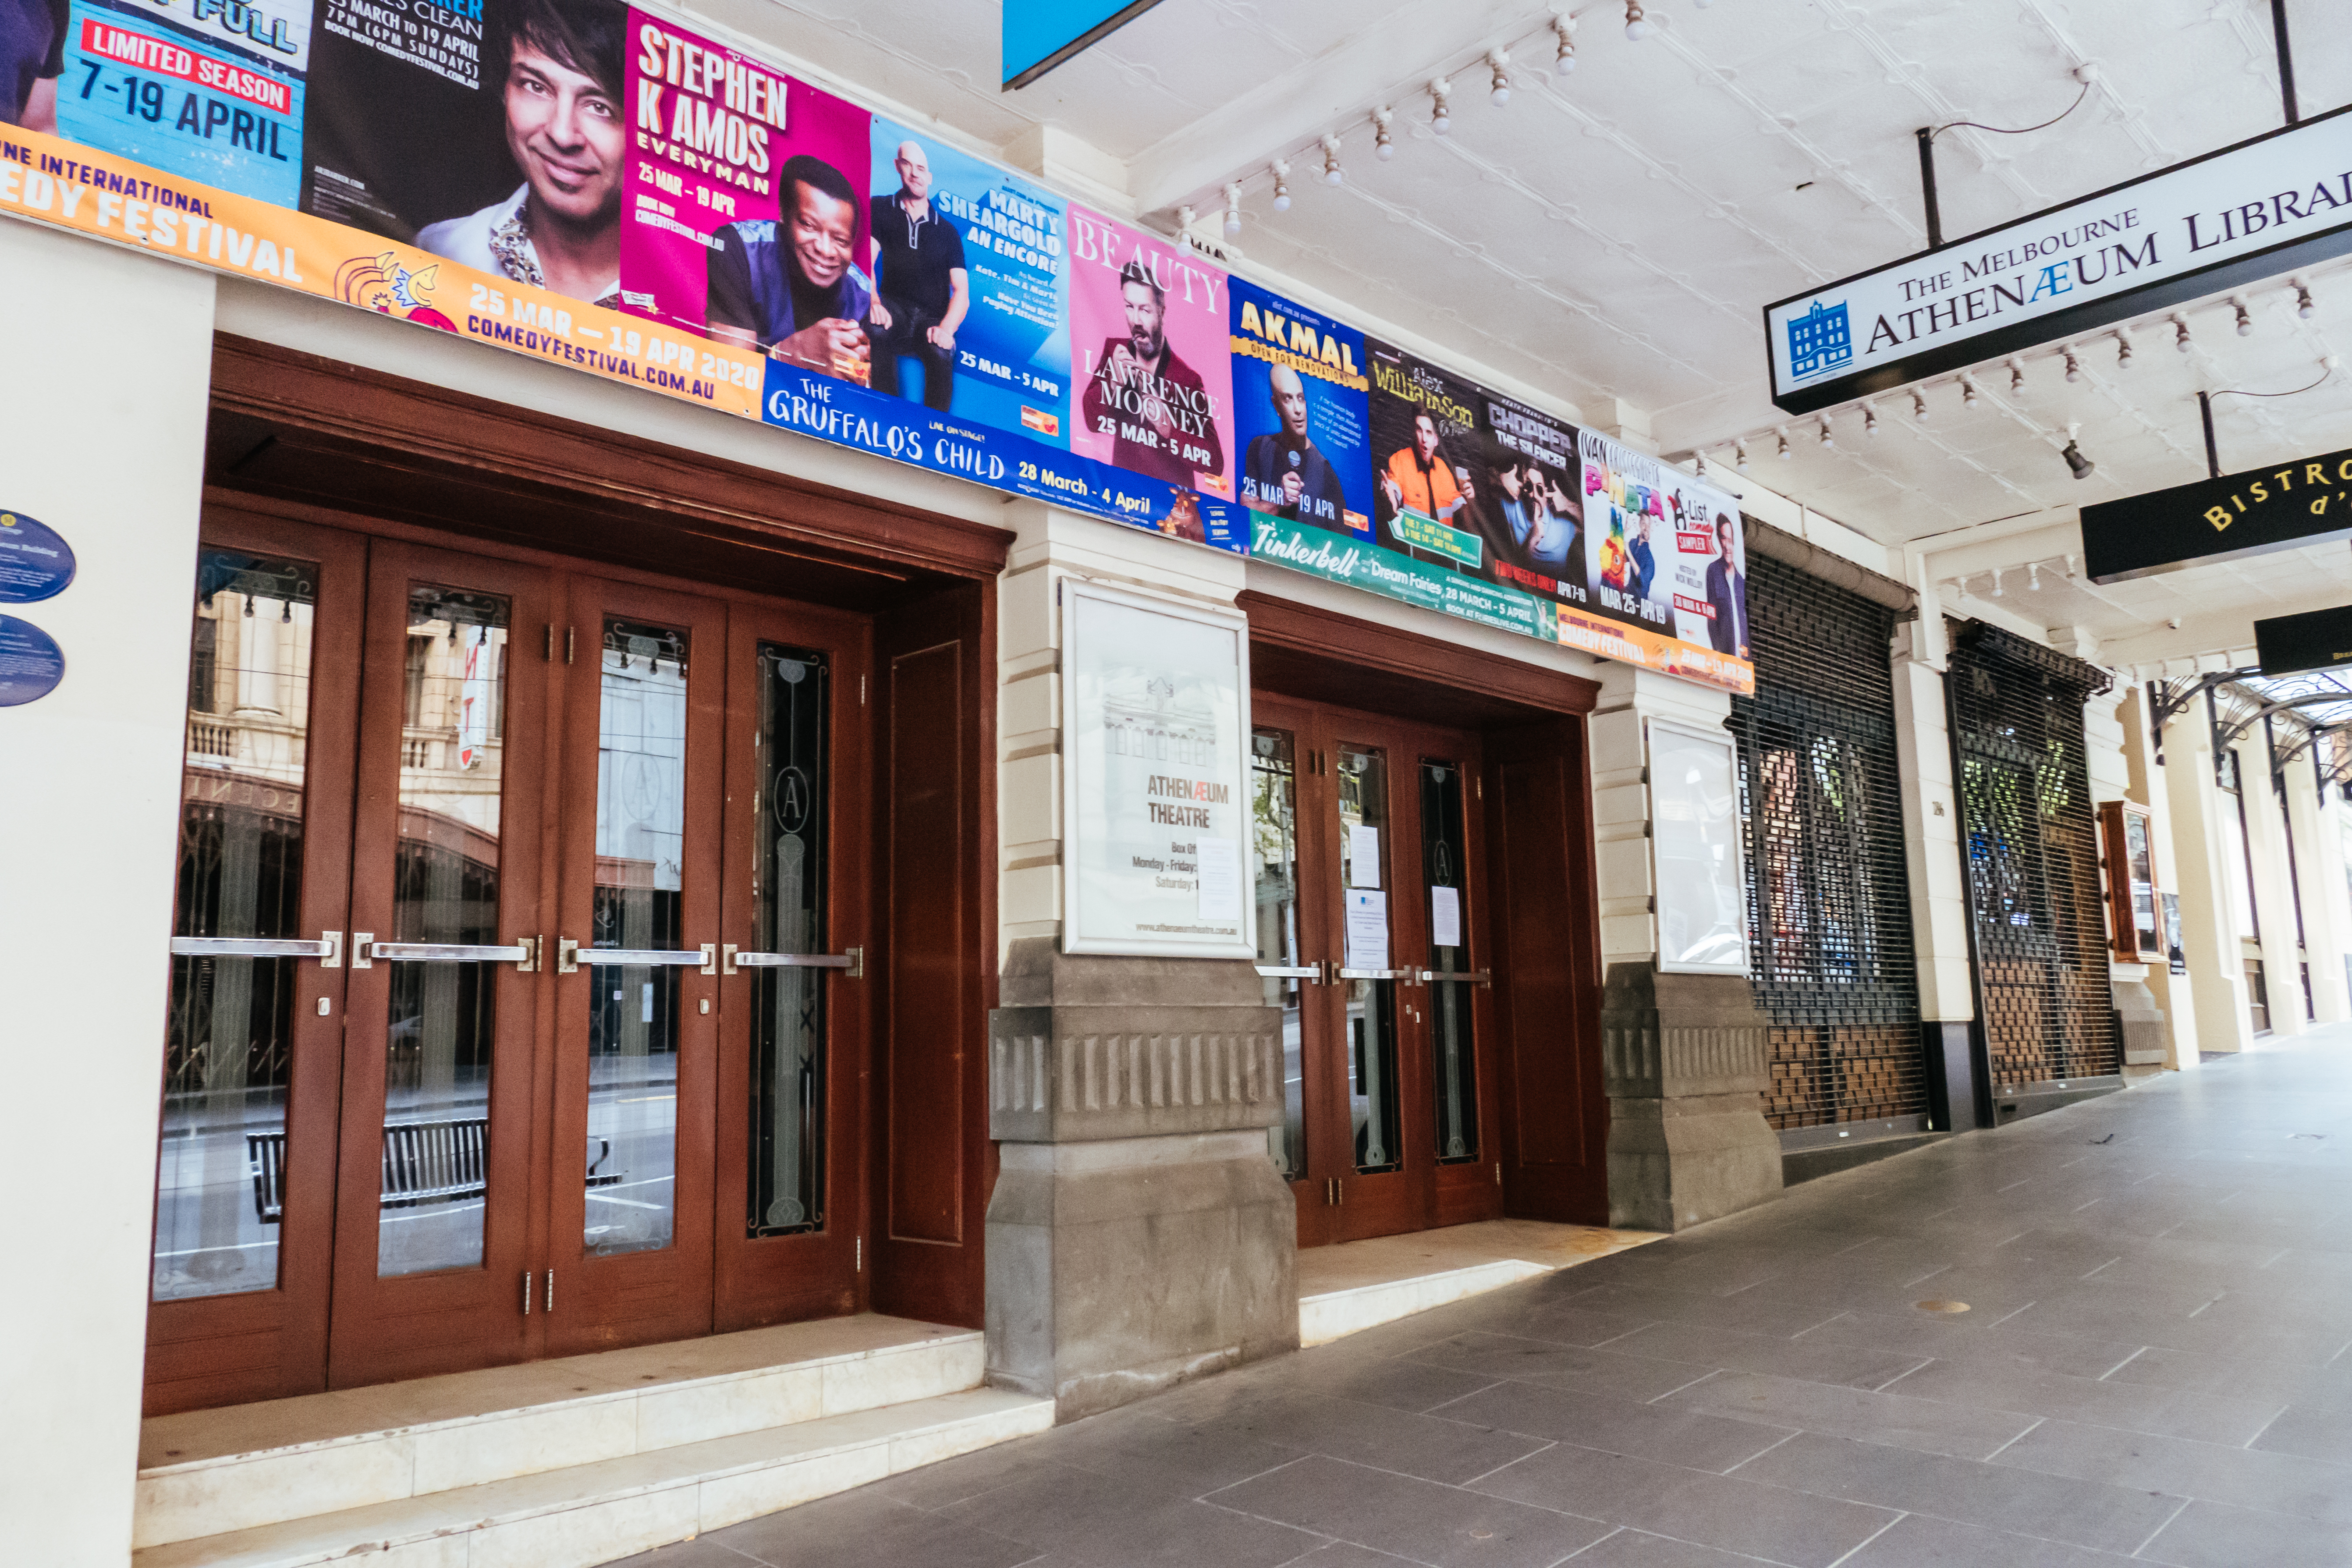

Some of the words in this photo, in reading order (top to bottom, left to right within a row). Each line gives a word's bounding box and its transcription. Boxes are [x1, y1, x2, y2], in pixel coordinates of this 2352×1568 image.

[324, 20, 351, 38] BOOK
[351, 31, 375, 47] NOW
[327, 5, 358, 29] 7PM
[409, 39, 479, 79] SUNDAYS)
[351, 0, 401, 30] MARCH
[404, 20, 418, 35] TO
[422, 25, 440, 44] 19
[442, 33, 480, 62] APRIL
[414, 1, 482, 40] CLEAN
[93, 26, 192, 76] LIMITED
[198, 59, 284, 109] SEASON
[638, 24, 788, 131] STEPHEN
[175, 92, 287, 162] APRIL
[637, 77, 663, 134] K
[670, 93, 770, 174] AMOS
[40, 153, 213, 219] INTERNATIONAL
[637, 131, 770, 195] EVERYMAN
[639, 161, 654, 184] 25
[655, 168, 682, 197] MAR
[696, 185, 710, 207] 19
[711, 191, 736, 217] APR
[96, 191, 303, 283] FESTIVAL
[938, 189, 1061, 258] SHEARGOLD
[989, 188, 1059, 235] MARTY
[967, 226, 992, 249] AN
[994, 237, 1058, 277] ENCORE
[1073, 217, 1222, 315] BEAUTY
[1961, 208, 2140, 283] MELBOURNE
[468, 314, 715, 400] COMEDYFESTIVAL.COM.AU
[469, 283, 505, 316] 25
[513, 299, 571, 338] MAR
[610, 326, 642, 356] 19
[646, 338, 695, 372] APR
[701, 353, 760, 391] 2020
[1240, 301, 1358, 376] AKMAL
[1251, 343, 1271, 358] OPEN
[1275, 352, 1291, 366] FOR
[799, 378, 832, 403] THE
[960, 350, 976, 368] 25
[978, 358, 1011, 380] MAR
[1022, 372, 1030, 386] 5
[1032, 377, 1059, 397] APR
[1084, 349, 1221, 420] LAWRENCE
[1099, 380, 1209, 438] MOONEY
[935, 438, 1005, 480] CHILD
[1097, 415, 1117, 436] 25
[1121, 422, 1158, 449] MAR
[1170, 438, 1179, 455] 5
[1182, 443, 1211, 467] APR
[1495, 429, 1519, 451] THE
[1018, 461, 1037, 481] 28
[1041, 468, 1088, 496] March
[1102, 488, 1111, 504] 4
[1115, 491, 1150, 514] April
[1243, 476, 1257, 497] 25
[1260, 482, 1284, 506] MAR
[1298, 493, 1311, 513] 19
[1314, 498, 1335, 520] APR
[1252, 524, 1359, 578] Tinkerbell
[1371, 561, 1408, 585] Dream
[1446, 587, 1458, 600] 28
[1459, 591, 1492, 611] MARCH
[1499, 603, 1506, 614] 5
[1507, 606, 1533, 622] APRIL
[1600, 585, 1622, 611] MAR
[1622, 592, 1636, 615] 25
[1559, 623, 1601, 650] COMEDY
[1600, 634, 1646, 663] FESTIVAL
[1147, 774, 1229, 805] ATHENÆUM
[1147, 802, 1210, 829] THEATRE
[1132, 856, 1165, 872] Monday
[1171, 841, 1185, 854] Box
